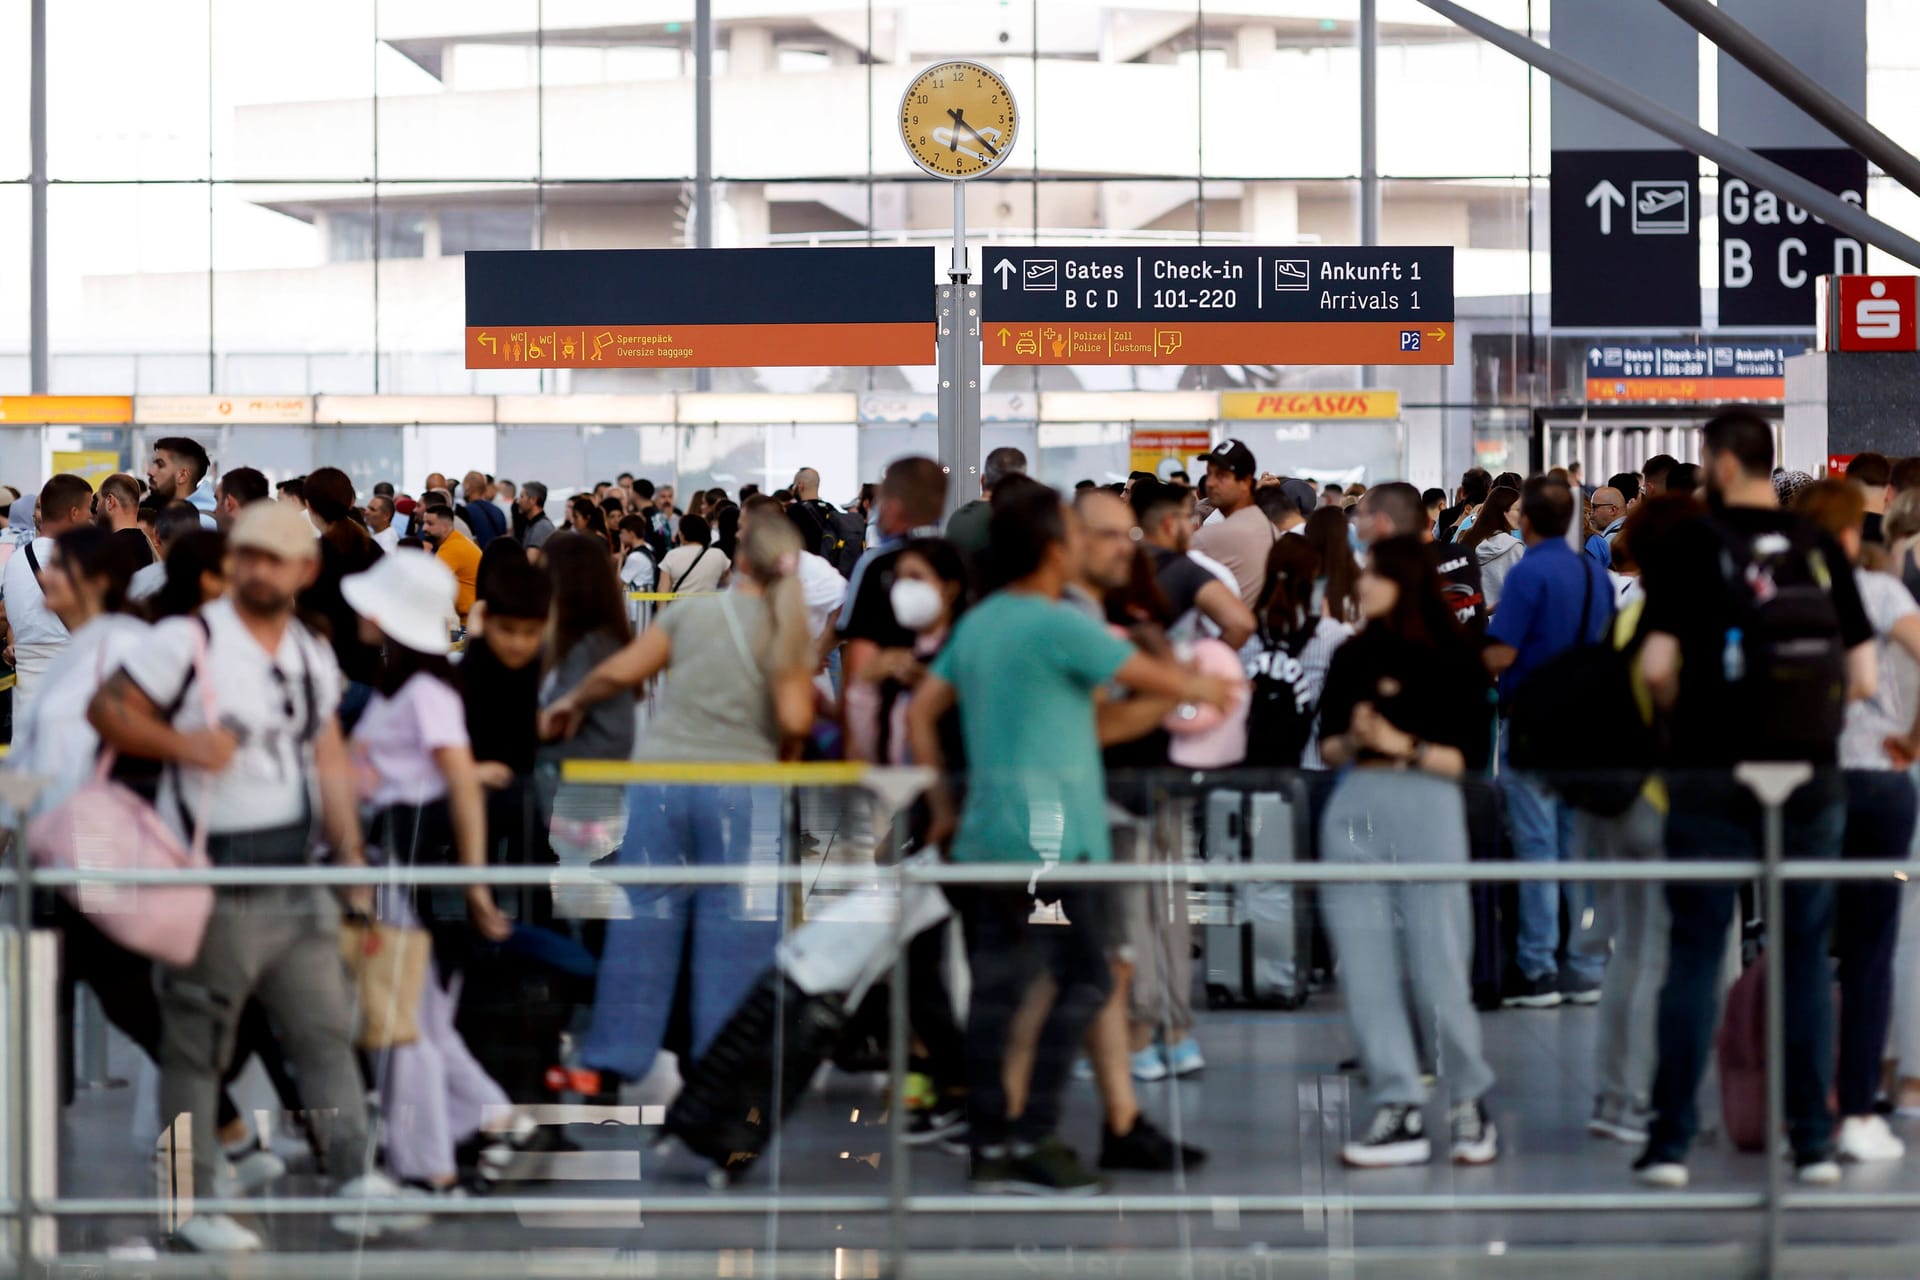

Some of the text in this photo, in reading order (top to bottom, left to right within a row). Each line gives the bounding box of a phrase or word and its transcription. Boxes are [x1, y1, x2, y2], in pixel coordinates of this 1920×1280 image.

[953, 72, 964, 82] 12
[932, 79, 945, 89] 11
[976, 79, 983, 88] 1
[917, 95, 928, 105] 10
[991, 94, 998, 105] 2
[912, 115, 919, 125] 9
[998, 115, 1005, 124] 3
[919, 136, 926, 146] 8
[934, 152, 940, 162] 7
[956, 157, 963, 167] 6
[978, 152, 984, 162] 5
[1724, 238, 1753, 288] B
[1778, 238, 1807, 289] C
[1065, 260, 1124, 279] Gates
[1154, 260, 1243, 279] Check-in
[1320, 261, 1421, 281] Ankunft 1
[1065, 290, 1118, 308] B C D
[1153, 289, 1236, 308] 101-220
[1320, 291, 1421, 309] Arrivals 1
[511, 333, 524, 342] WC
[539, 335, 552, 345] WC
[617, 333, 673, 345] Sperrgepäck
[1073, 331, 1106, 341] Polizei
[1114, 331, 1132, 341] Zoll
[1073, 343, 1102, 352] Police
[1114, 342, 1152, 352] Customs
[617, 347, 693, 359] Oversize baggage
[1257, 393, 1368, 415] PEGASUS
